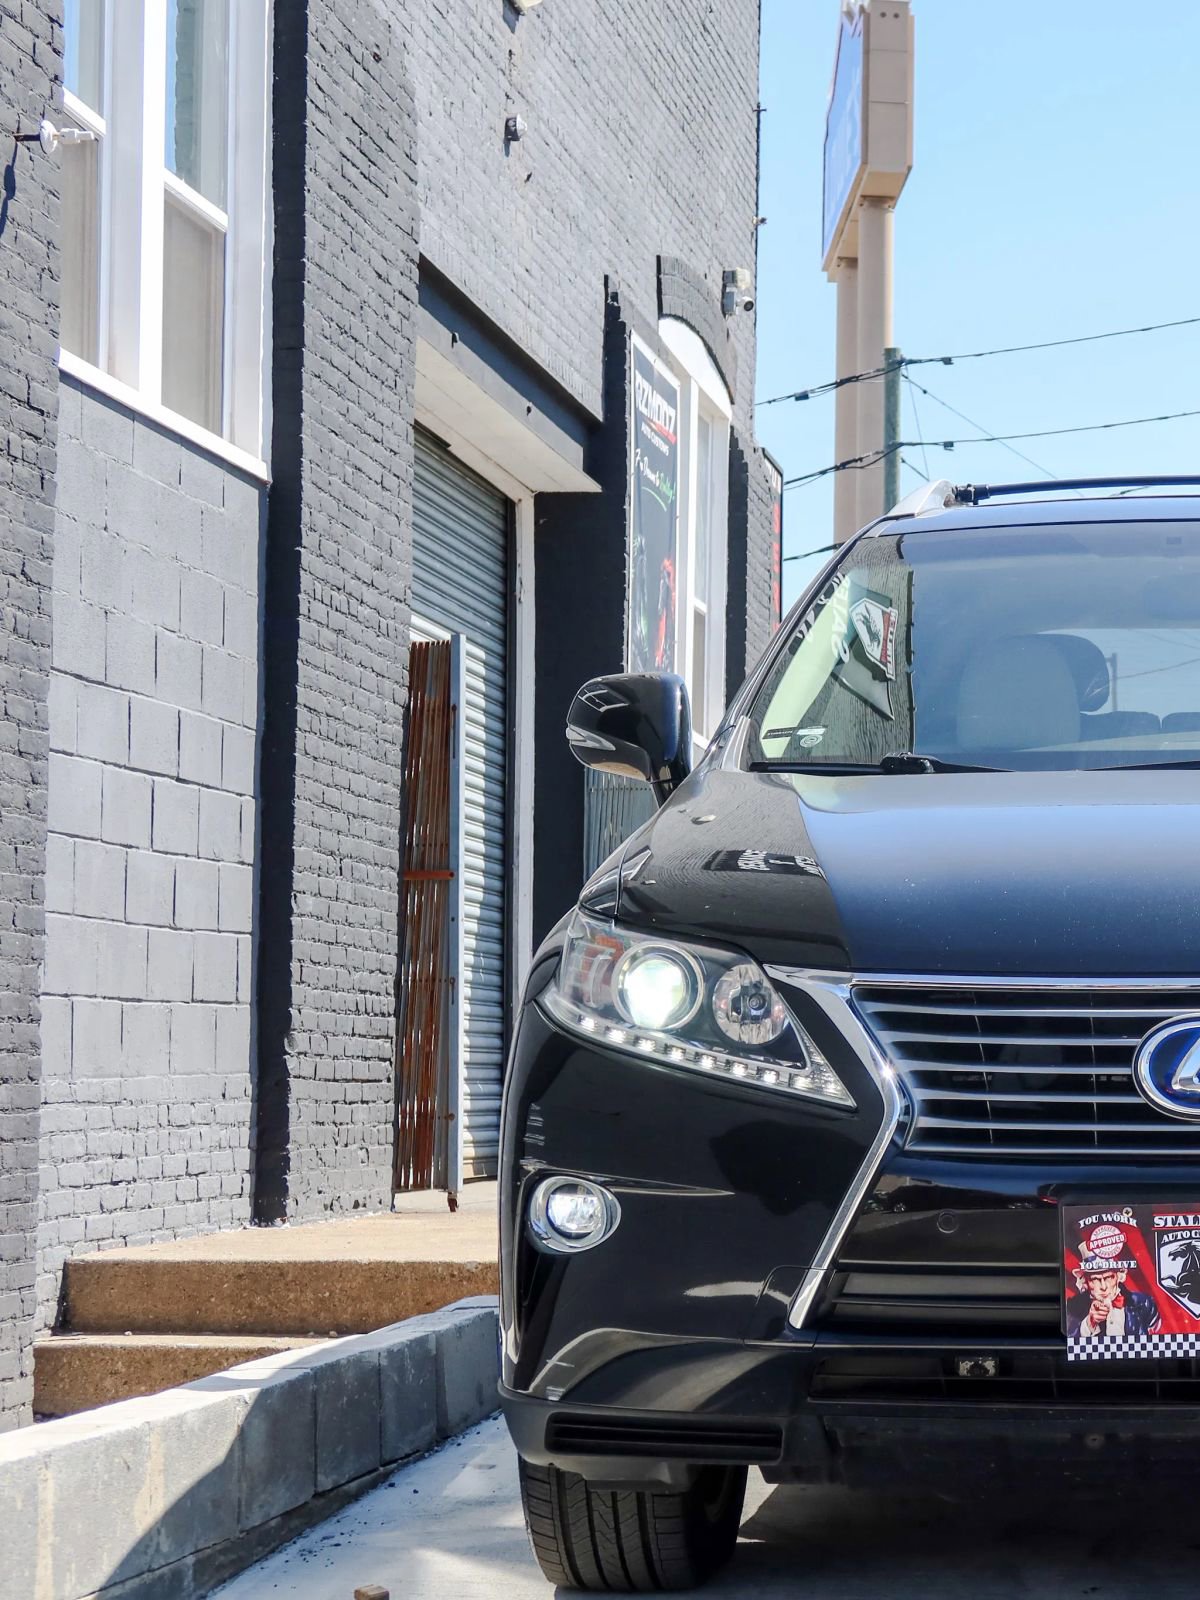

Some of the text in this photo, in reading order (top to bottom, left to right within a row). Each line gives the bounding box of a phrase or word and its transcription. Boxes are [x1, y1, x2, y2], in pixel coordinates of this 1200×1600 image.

[1078, 1213, 1138, 1229] YOU WORK
[1089, 1234, 1125, 1250] APPROVED
[1161, 1230, 1191, 1244] AUTO
[1079, 1260, 1137, 1270] YOU DRIVE
